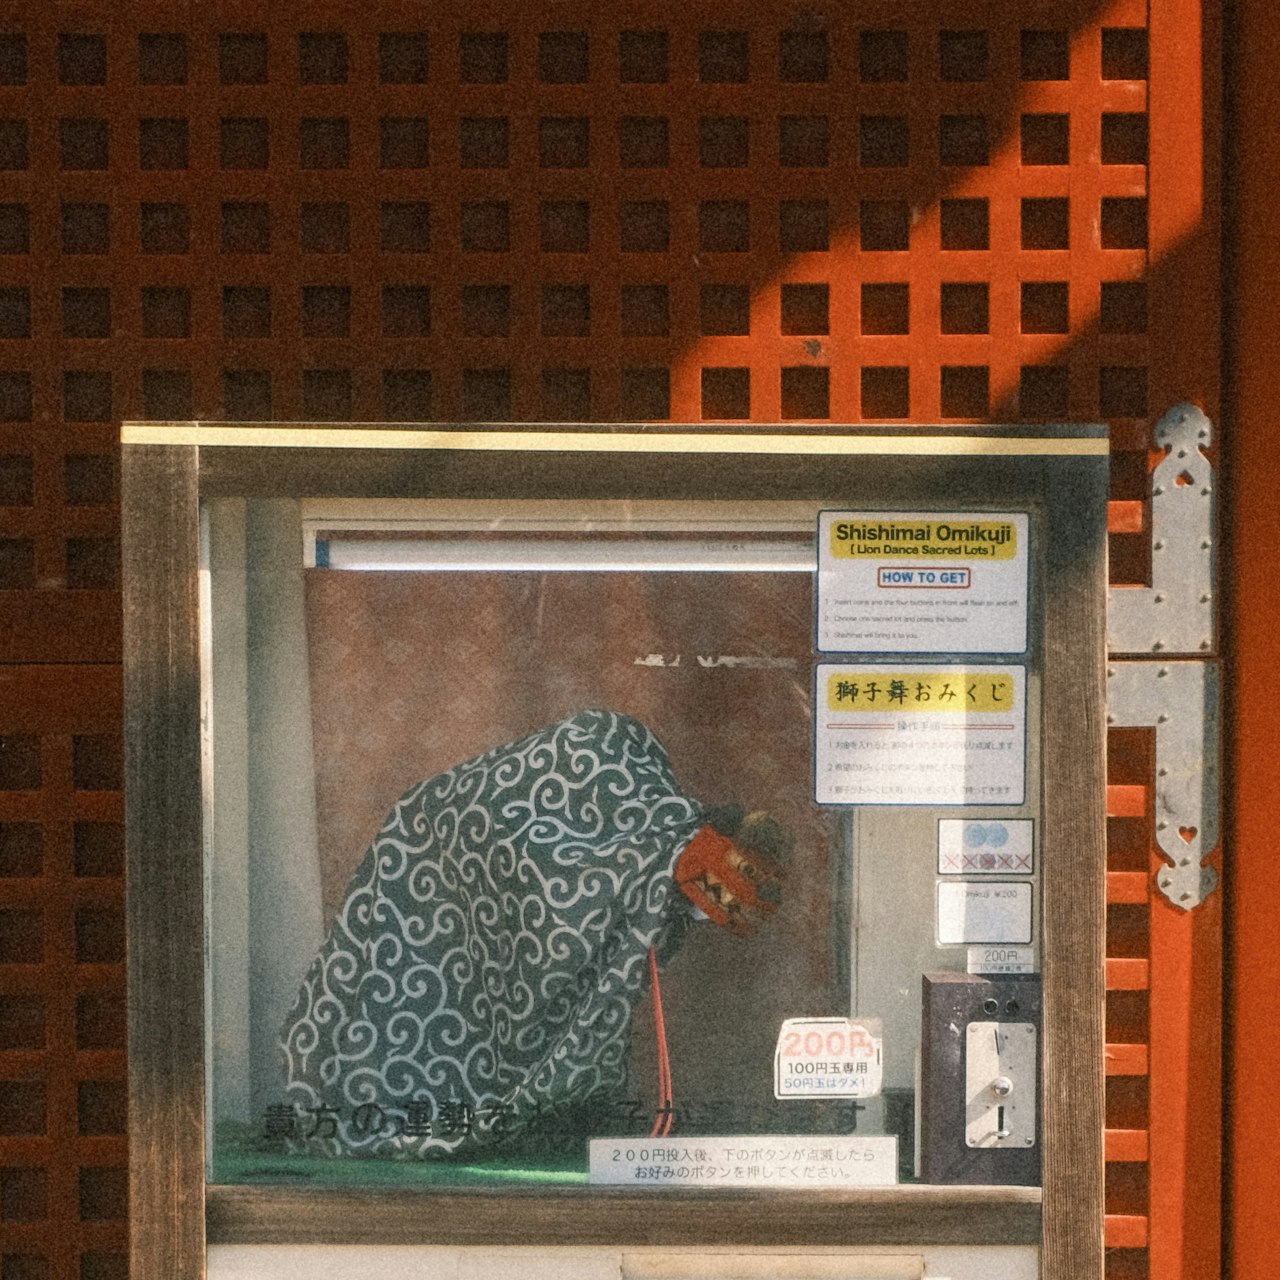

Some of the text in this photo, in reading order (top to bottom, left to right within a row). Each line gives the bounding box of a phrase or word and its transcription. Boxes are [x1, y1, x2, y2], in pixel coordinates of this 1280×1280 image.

[836, 524, 1011, 545] Shishimai Omikuji
[858, 545, 880, 554] Lion
[884, 545, 918, 555] Dance
[922, 545, 961, 555] Sacred
[964, 545, 988, 555] Lots
[882, 572, 966, 584] HOW TO GET
[835, 680, 1007, 703] 獅子舞おみくじ
[985, 949, 1018, 962] 200円
[783, 1030, 875, 1058] 200円
[787, 1061, 868, 1075] 100円玉専用
